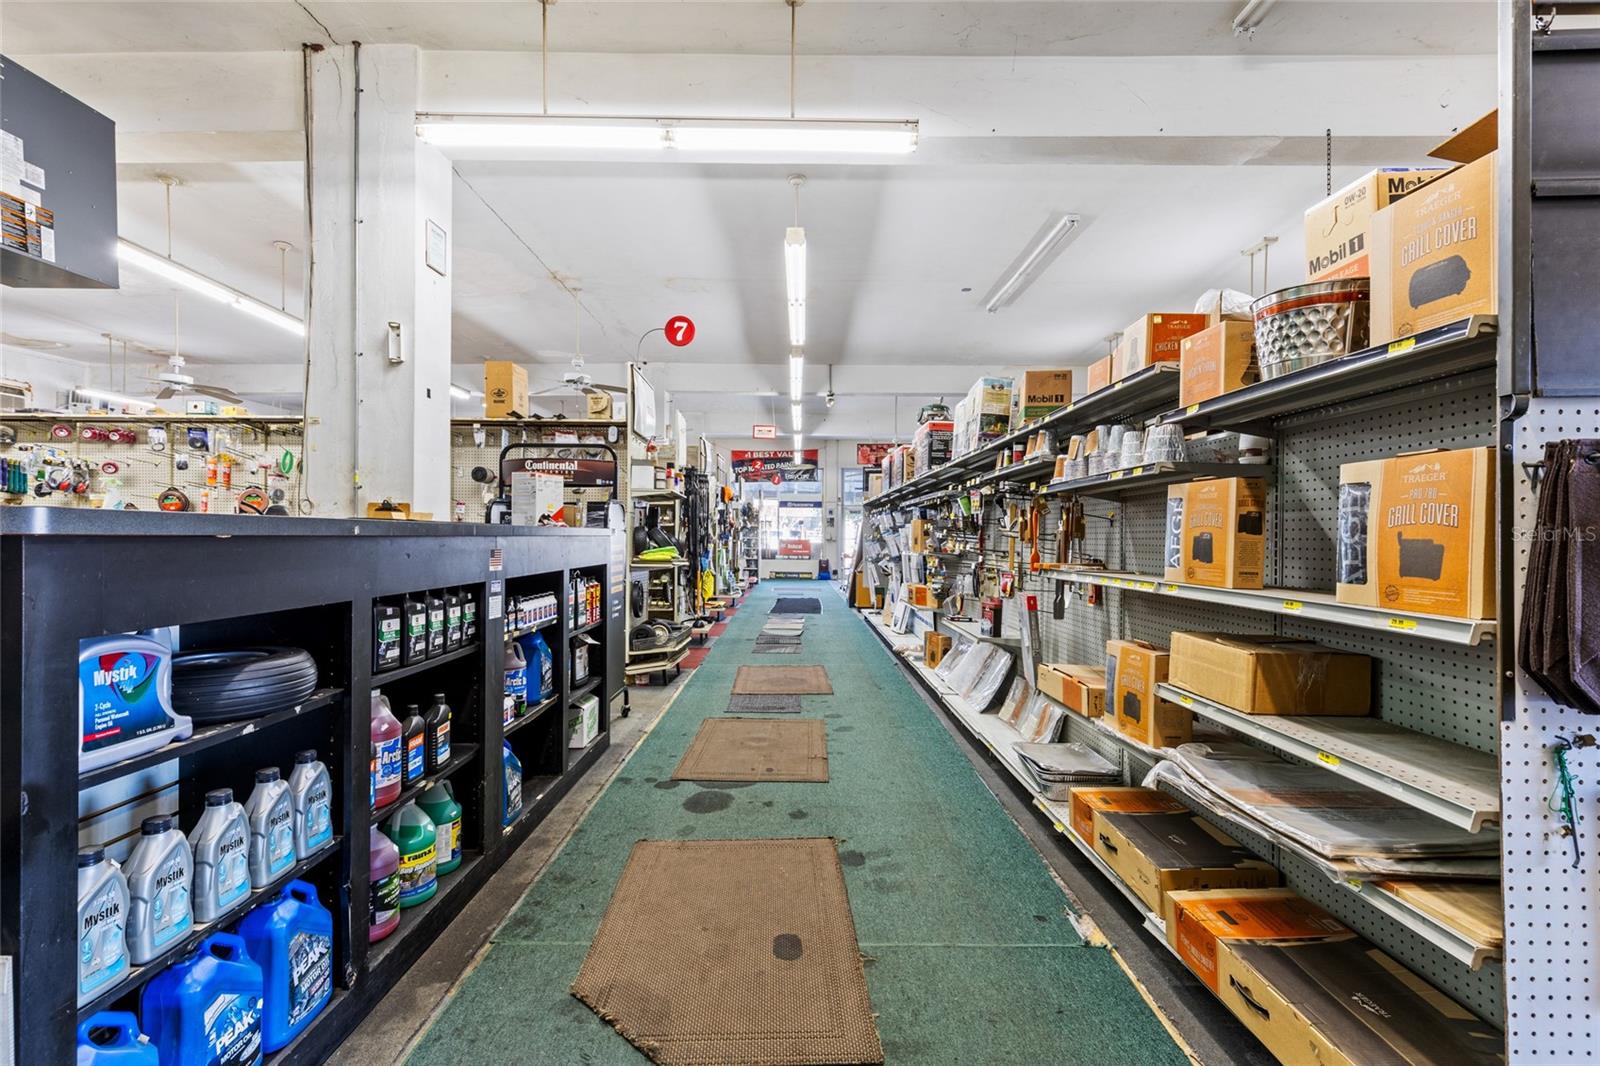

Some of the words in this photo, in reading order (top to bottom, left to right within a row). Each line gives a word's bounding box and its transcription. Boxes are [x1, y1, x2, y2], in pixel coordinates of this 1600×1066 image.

[1401, 231, 1432, 268] GRILL
[1435, 216, 1477, 250] COVER
[1309, 242, 1347, 276] Mobil
[674, 322, 688, 341] 7
[1027, 394, 1054, 404] Mobil
[525, 459, 578, 471] Continental
[755, 461, 761, 469] 2
[1402, 472, 1447, 484] TRAEGER
[1387, 503, 1417, 529] GRILL
[1419, 502, 1459, 528] COVER
[93, 664, 138, 687] Mystik
[270, 811, 290, 827] Mystik
[220, 836, 245, 856] Mystik
[155, 867, 185, 890] Mystik
[84, 902, 120, 930] Mystik
[292, 941, 329, 988] PEAK
[215, 1008, 256, 1056] PEAK
[220, 1040, 241, 1066] MOTOR
